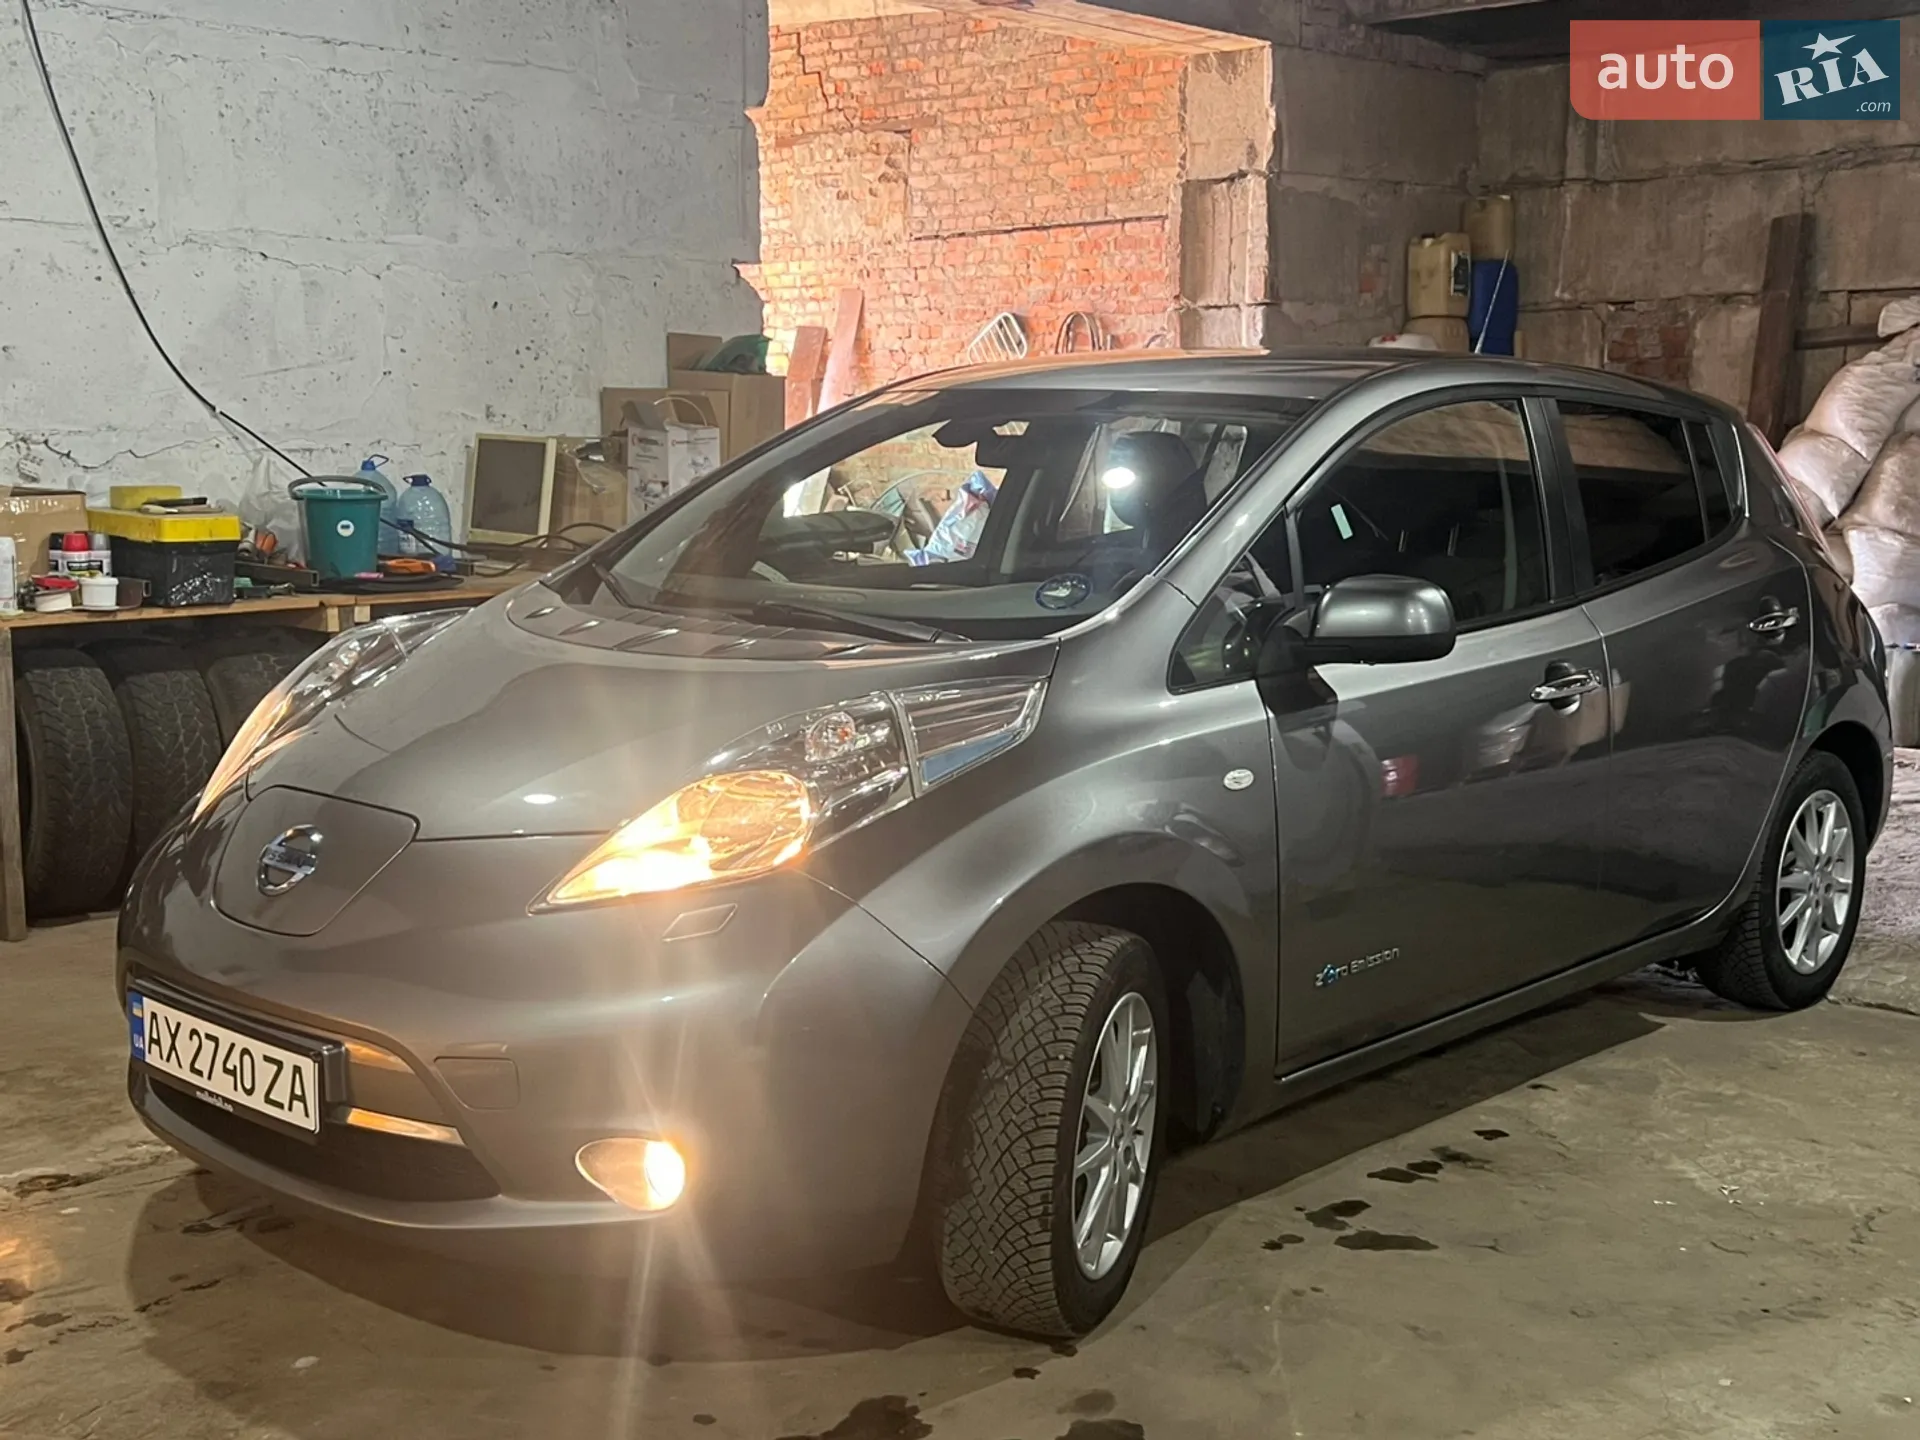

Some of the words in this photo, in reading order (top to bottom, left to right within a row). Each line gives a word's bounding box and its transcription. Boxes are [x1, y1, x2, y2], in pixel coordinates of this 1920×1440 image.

[133, 1033, 144, 1050] UA
[148, 1011, 182, 1069] AX
[189, 1028, 255, 1096] 2740
[263, 1054, 309, 1118] ZA
